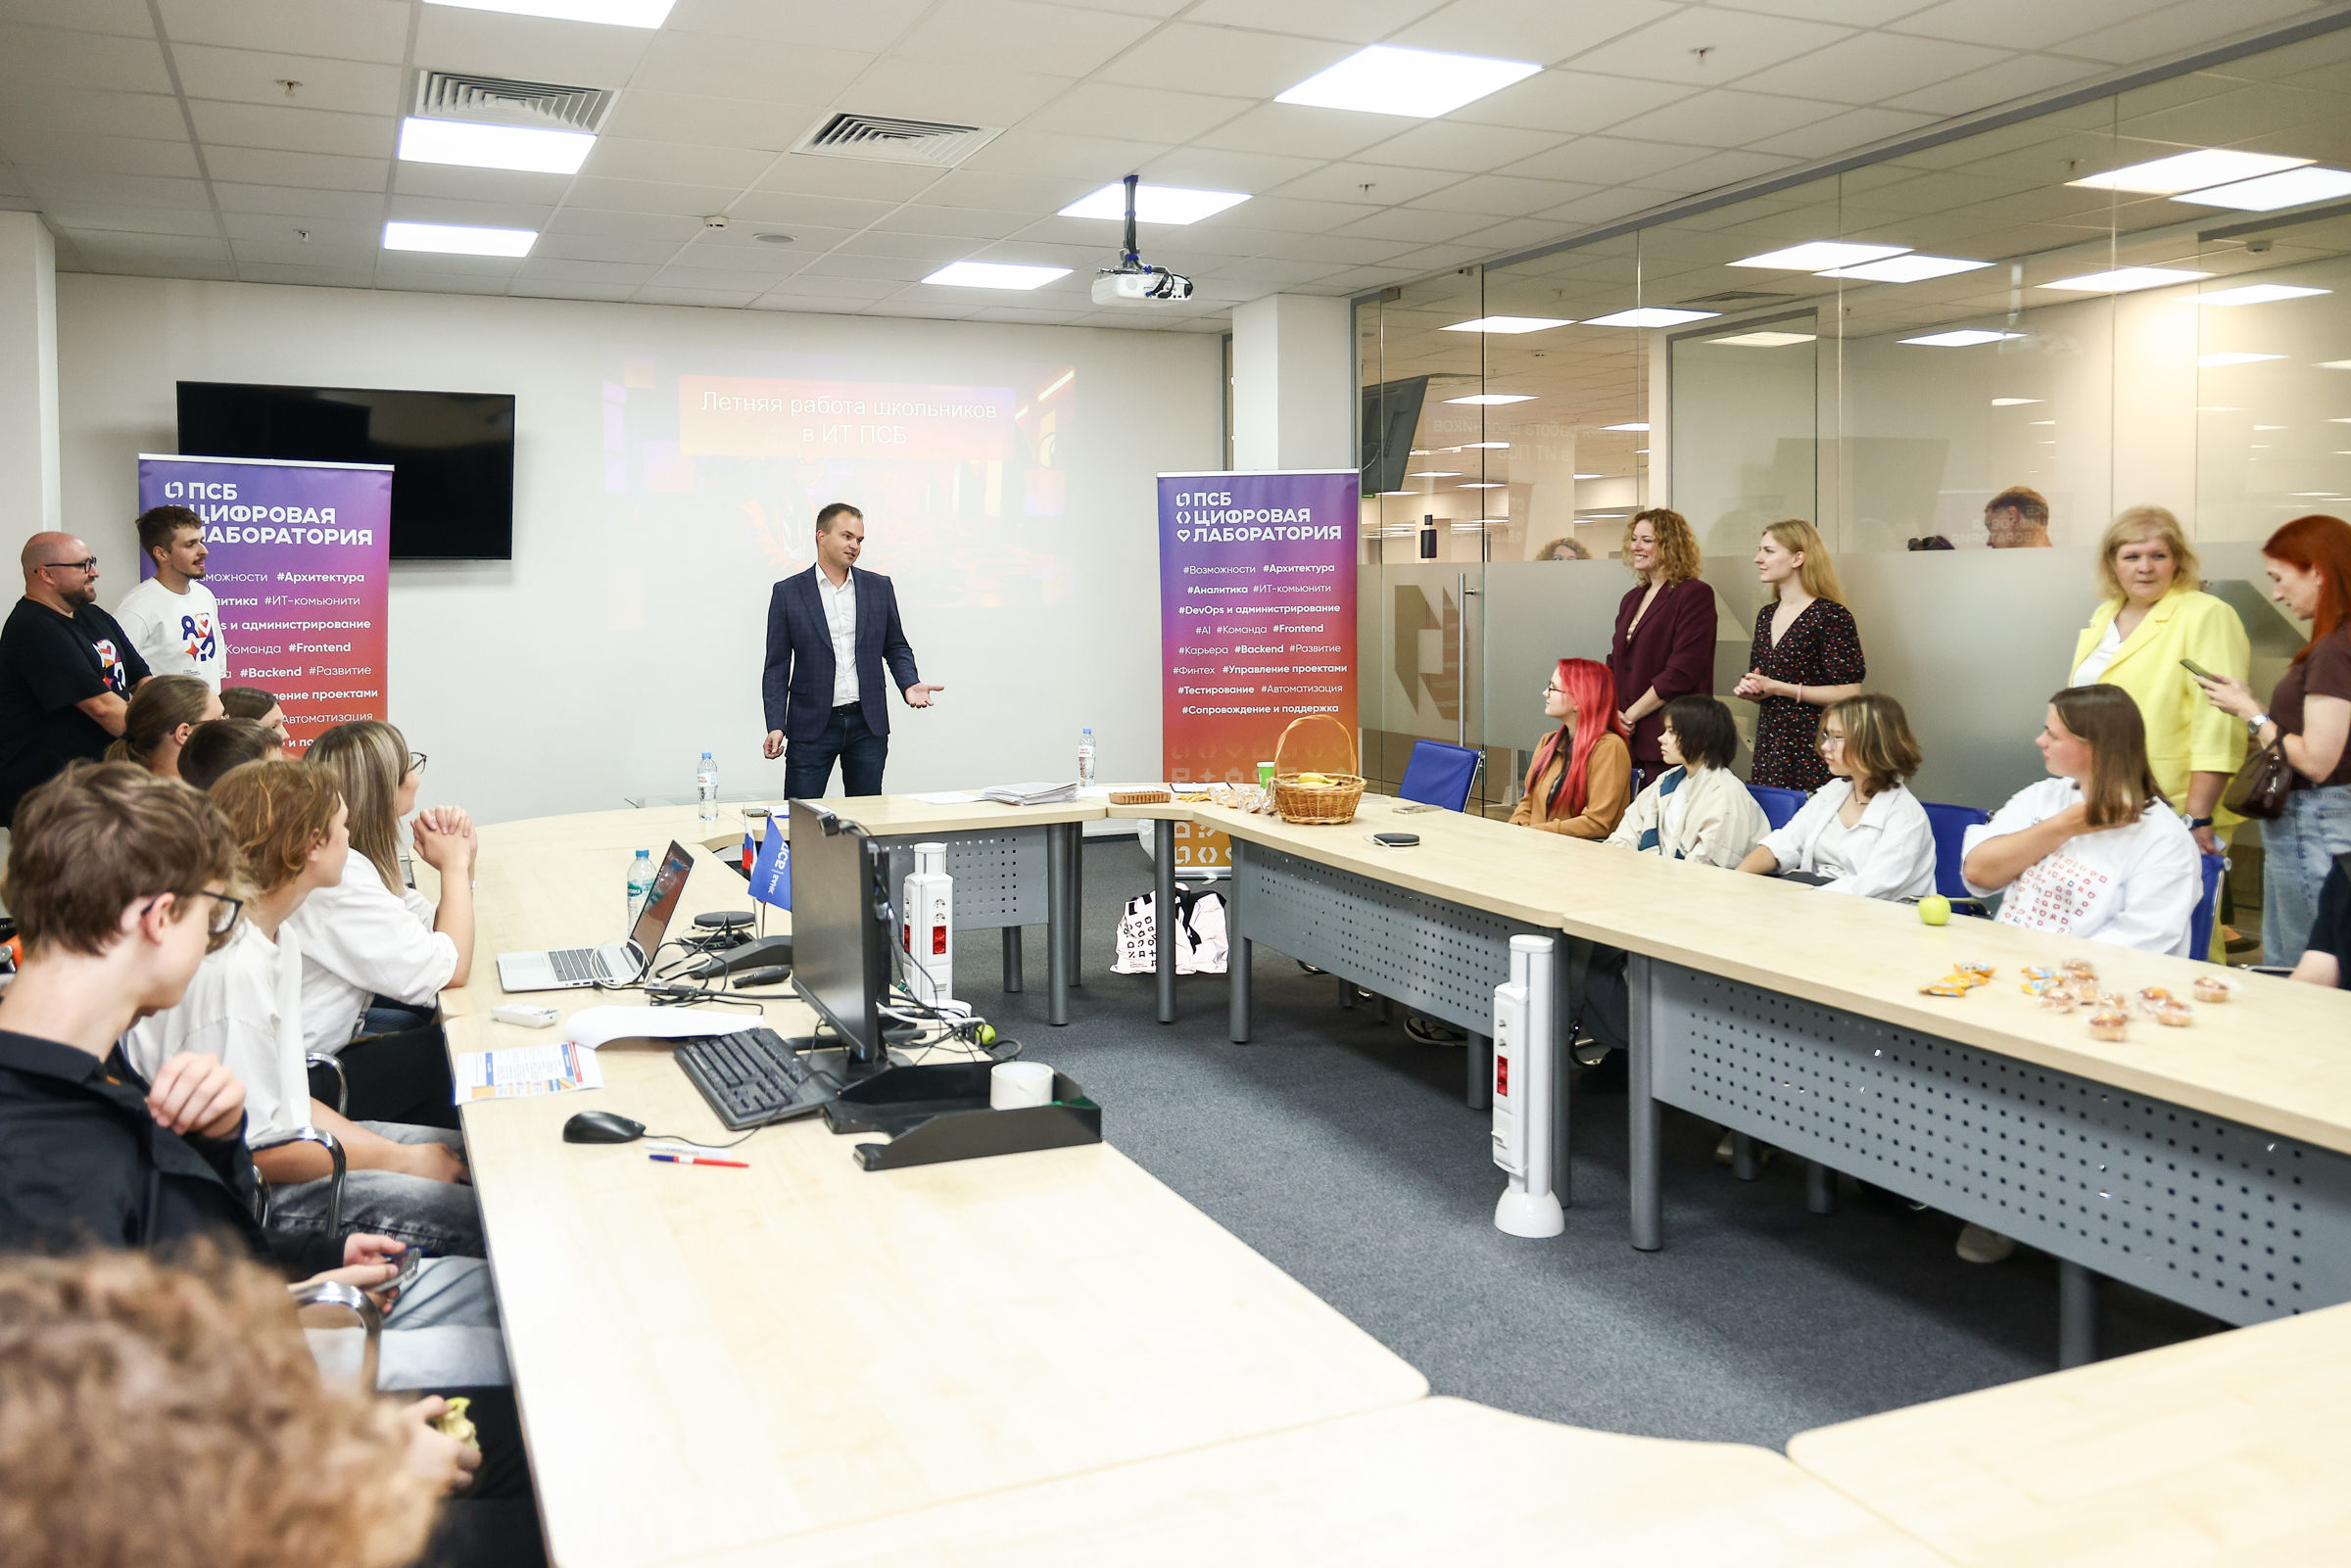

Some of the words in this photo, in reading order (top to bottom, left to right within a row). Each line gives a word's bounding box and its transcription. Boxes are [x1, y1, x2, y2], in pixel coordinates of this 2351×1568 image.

[700, 390, 783, 413] Летняя
[790, 394, 866, 417] работа
[873, 400, 997, 420] школьников
[802, 428, 815, 444] в
[822, 424, 851, 444] ИТ
[860, 425, 908, 446] ПСБ
[188, 481, 238, 500] ПСБ
[1194, 492, 1232, 507] ПСБ
[1194, 508, 1311, 526] ЦИФРОВАЯ
[1192, 525, 1342, 543] ЛАБОРАТОРИЯ
[1183, 565, 1256, 575] #Возможности
[1263, 563, 1335, 574] #Архитектура
[276, 571, 365, 585] #Архитектура
[1187, 586, 1248, 594] #Аналитика
[1253, 584, 1332, 594] #ИТ-комьюнити
[264, 594, 360, 606] #ИТ-комьюнити
[1178, 605, 1224, 616] #DevOps
[1235, 604, 1341, 615] администрирование
[241, 619, 371, 632] администрирование
[1217, 625, 1268, 635] #Команда
[1272, 624, 1324, 633] #Frontend
[225, 643, 281, 654] Команда
[288, 641, 352, 652] #Frontend
[1178, 646, 1228, 655] #Карьера
[1234, 644, 1284, 653] #Backend
[1289, 643, 1342, 653] #Развитие
[240, 666, 303, 678] #Backend
[308, 665, 372, 677] #Развитие
[1173, 666, 1215, 675] #Финтех
[1223, 665, 1290, 676] #Управление
[1292, 664, 1348, 674] проектами
[312, 689, 378, 702] проектами
[1177, 686, 1255, 695] #Тестирование
[1261, 685, 1343, 694] #Автоматизация
[1182, 704, 1271, 715] #Сопровождение
[1282, 703, 1339, 714] поддержка
[282, 713, 373, 725] Автоматизация
